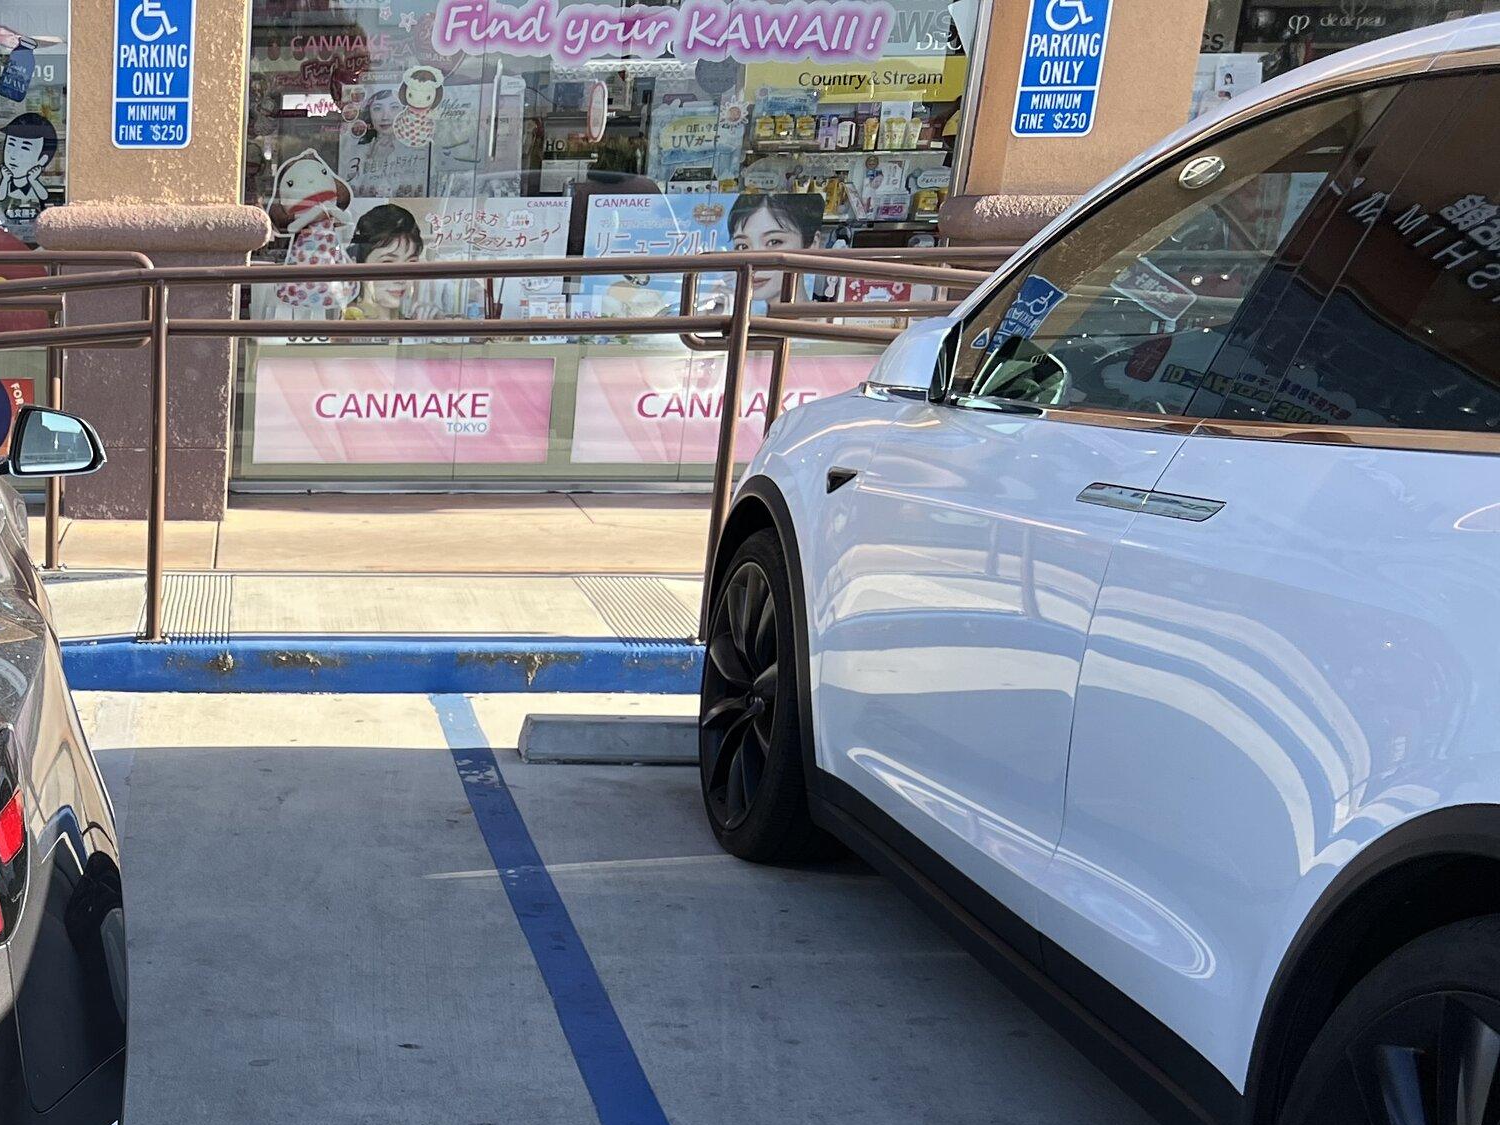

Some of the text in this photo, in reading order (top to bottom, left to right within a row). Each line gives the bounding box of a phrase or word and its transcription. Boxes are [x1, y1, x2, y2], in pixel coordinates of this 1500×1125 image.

[444, 4, 883, 54] Find your KAWAII!
[1028, 33, 1100, 58] PARKING
[120, 44, 188, 68] PARKING
[798, 71, 866, 90] Country
[882, 70, 944, 86] Stream
[1039, 61, 1084, 85] ONLY
[132, 72, 174, 95] ONLY
[1030, 93, 1081, 110] MINIMUM
[127, 104, 176, 121] MINIMUM
[1019, 113, 1086, 130] FINE $250
[119, 124, 183, 142] FINE $250
[527, 200, 569, 208] CANMAKE
[595, 198, 651, 208] CANMAKE
[315, 392, 490, 419] CANMAKE
[446, 422, 487, 433] TOKYO
